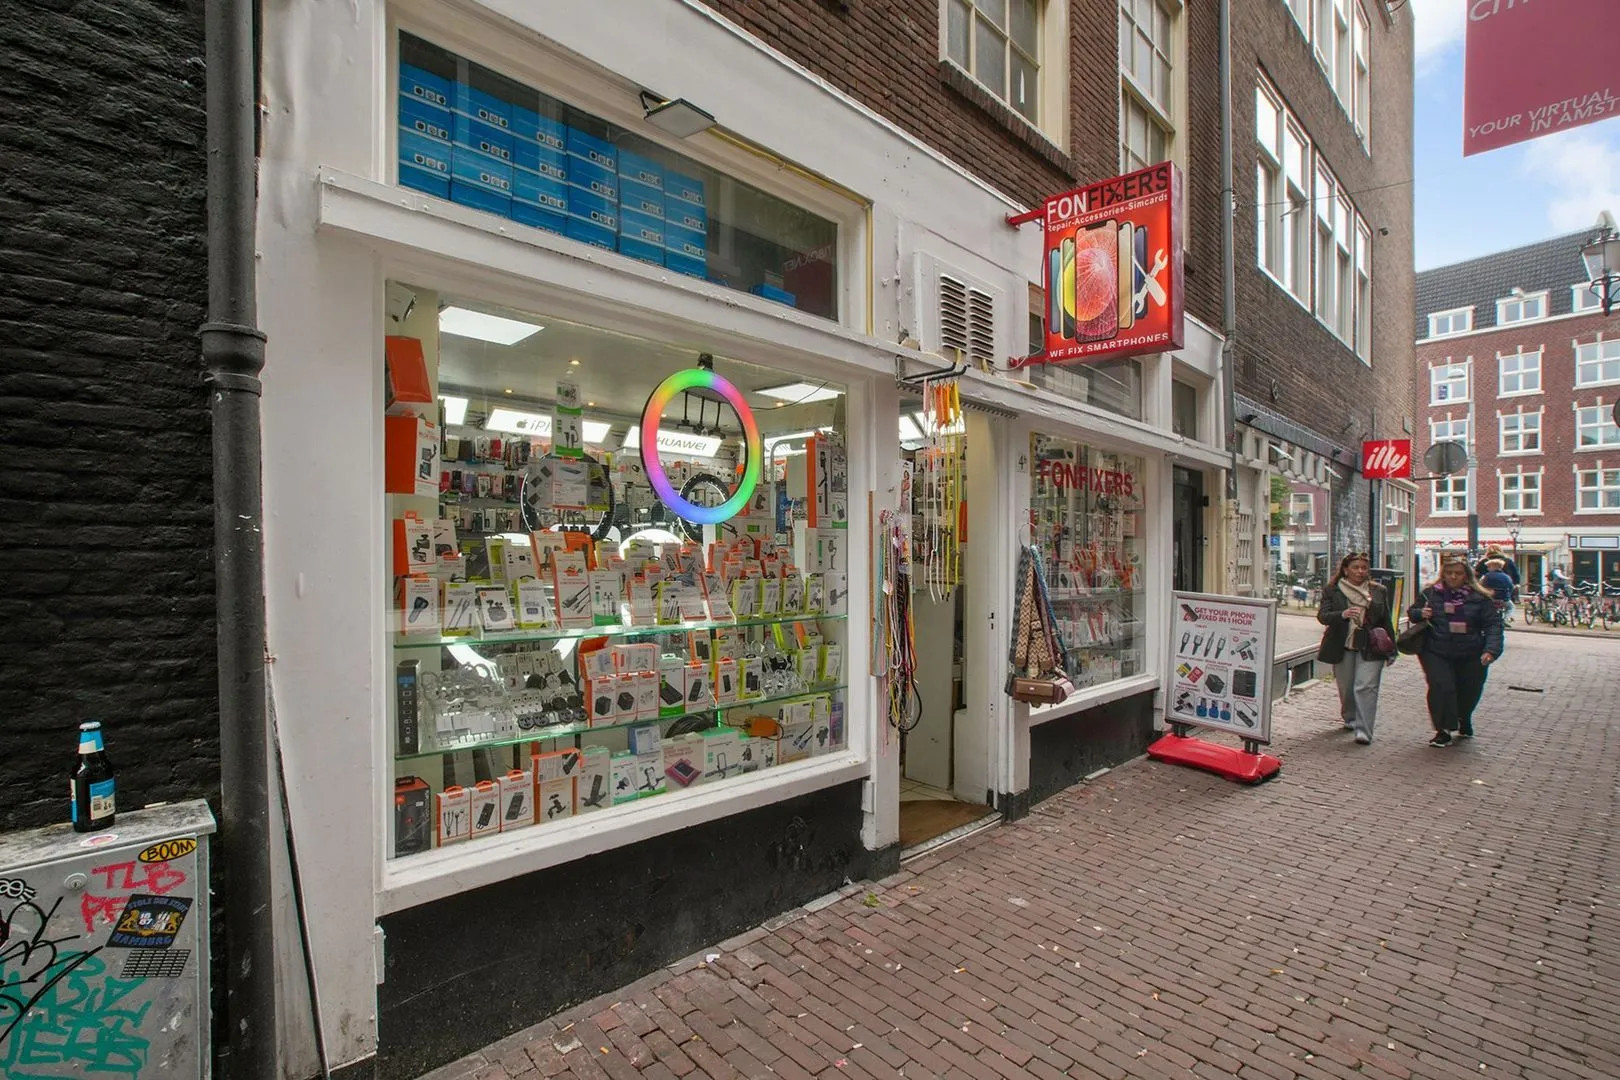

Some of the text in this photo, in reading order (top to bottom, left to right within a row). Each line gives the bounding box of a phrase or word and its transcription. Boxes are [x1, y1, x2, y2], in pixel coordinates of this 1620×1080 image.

[1469, 88, 1614, 138] YOUR VIRTUAL
[1530, 116, 1552, 133] IN
[1047, 167, 1168, 223] FONFIXERS
[1068, 346, 1083, 356] FIX
[1087, 332, 1169, 352] SMARTPHONES
[657, 436, 707, 451] HUAWEI
[1366, 445, 1408, 475] illy
[1040, 459, 1133, 497] FONFIXERS
[1194, 606, 1256, 621] GET YOUR PHONE
[1199, 614, 1218, 622] FIXED
[1231, 618, 1253, 626] HOUR
[147, 839, 194, 860] BOOM
